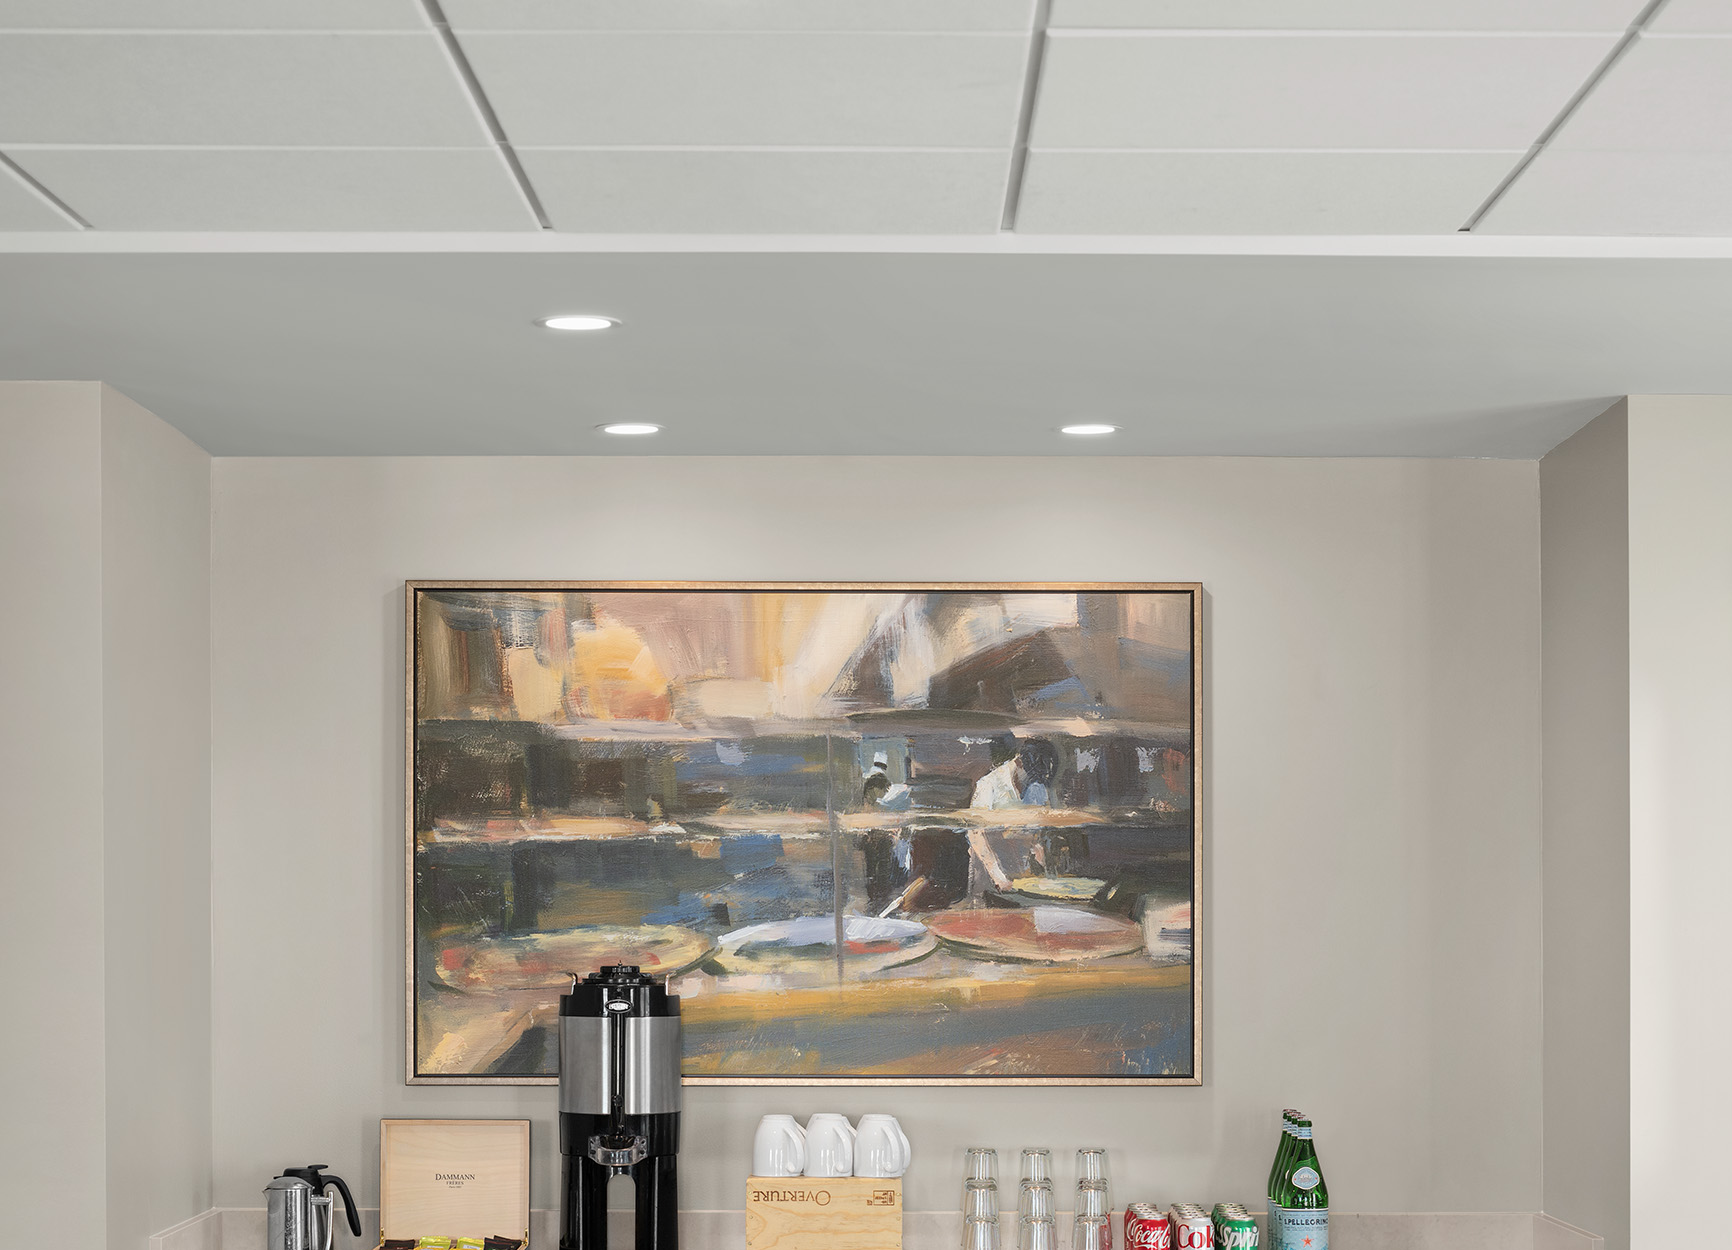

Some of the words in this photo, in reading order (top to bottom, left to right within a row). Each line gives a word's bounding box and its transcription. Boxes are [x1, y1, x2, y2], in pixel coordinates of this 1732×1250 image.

[435, 1173, 475, 1181] DAMMANN
[753, 1190, 831, 1205] OVERTURE
[1133, 1223, 1170, 1249] Coca-Co
[1177, 1223, 1215, 1249] Cok
